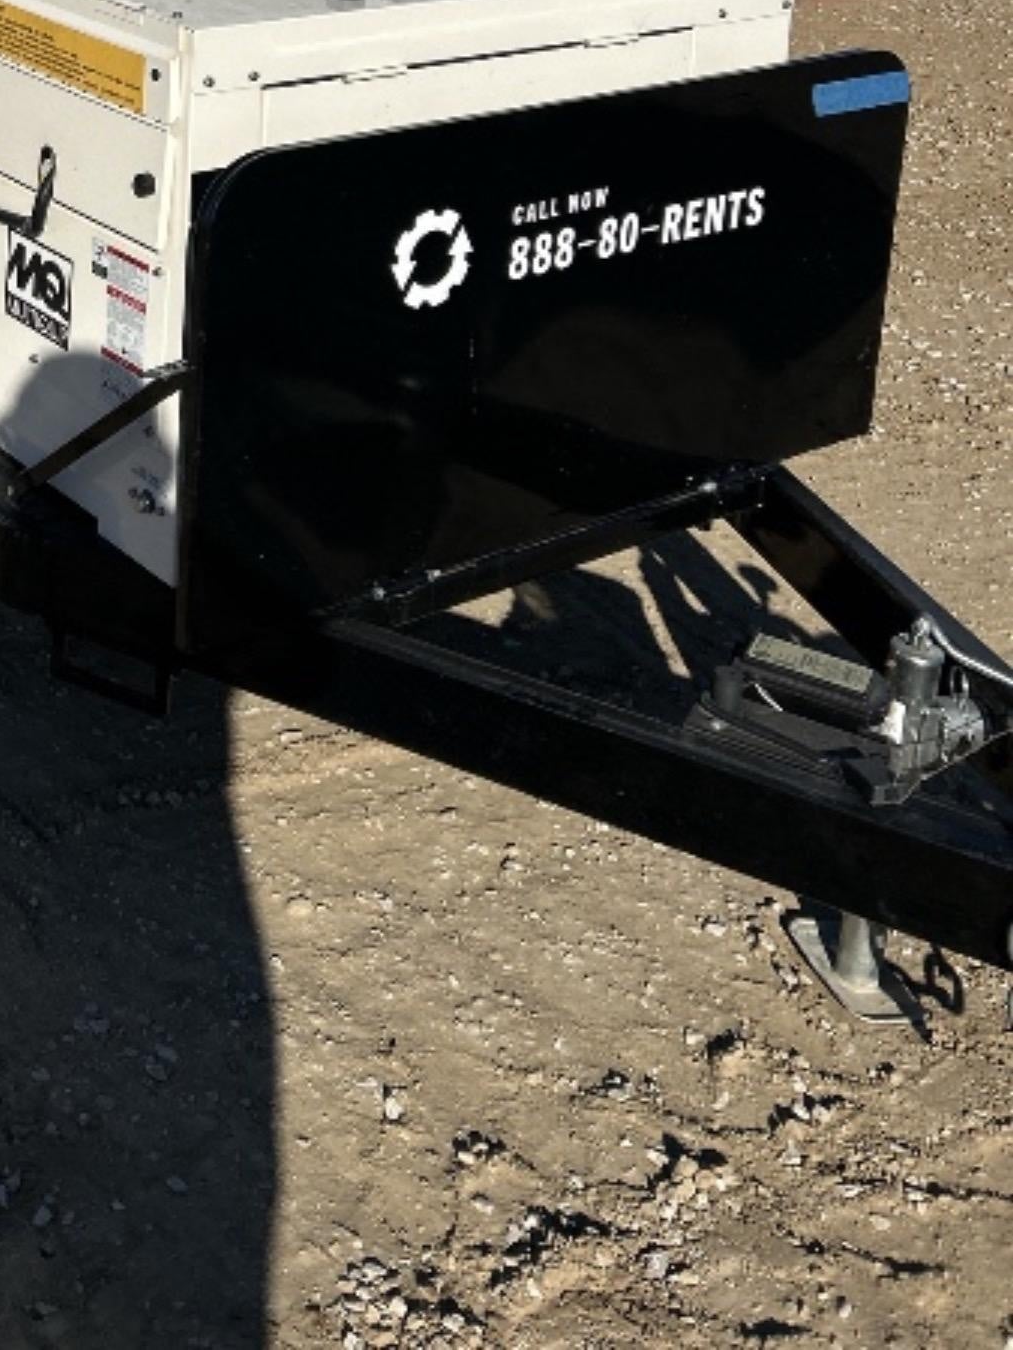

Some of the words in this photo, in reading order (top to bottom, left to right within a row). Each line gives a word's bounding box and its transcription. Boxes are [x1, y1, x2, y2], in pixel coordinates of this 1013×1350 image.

[508, 186, 766, 280] 888-80-RENTS
[512, 197, 559, 225] CALL
[568, 186, 610, 214] NOW
